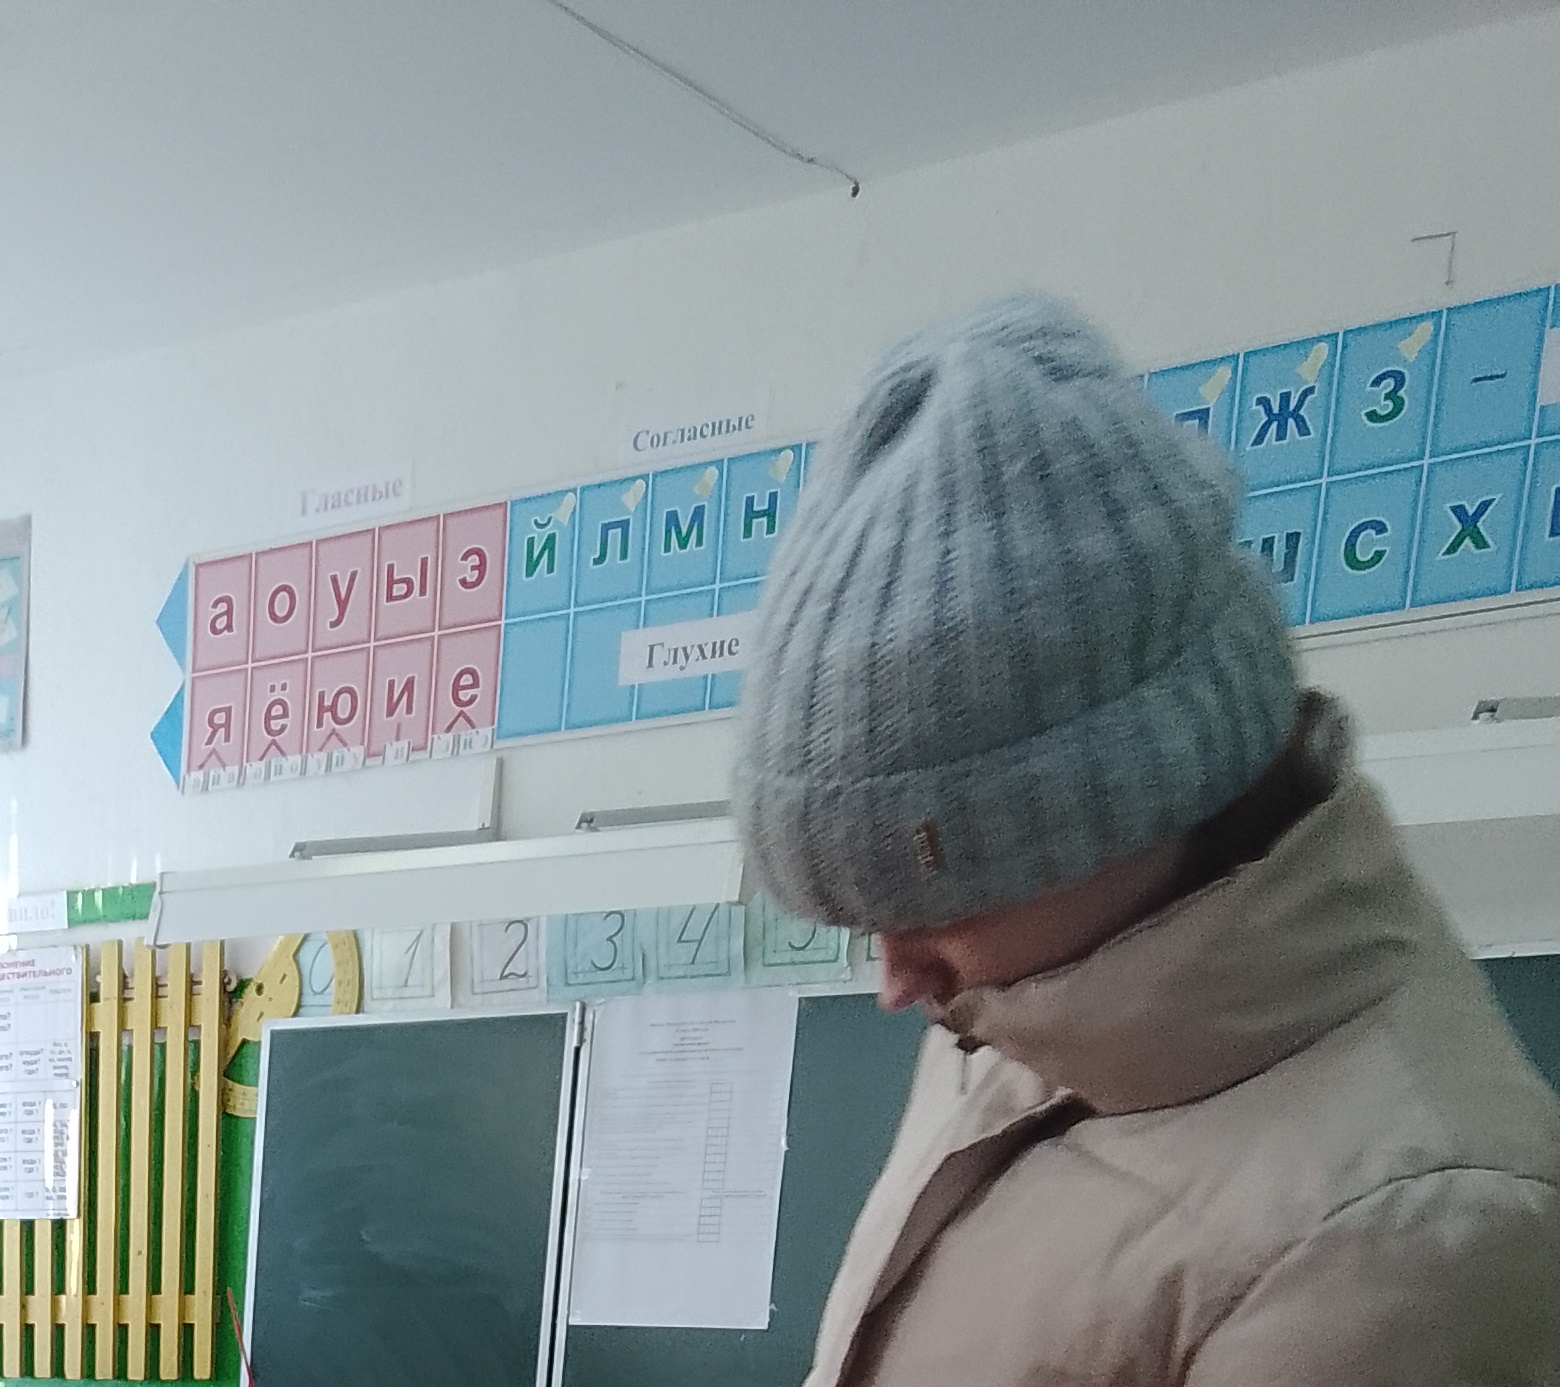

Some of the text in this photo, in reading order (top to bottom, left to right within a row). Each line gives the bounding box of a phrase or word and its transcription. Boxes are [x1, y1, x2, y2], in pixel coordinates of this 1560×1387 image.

[632, 413, 756, 453] Согласные
[300, 476, 404, 518] Гласные
[646, 635, 740, 671] Глухие
[404, 929, 424, 987] 1
[499, 919, 529, 981] 2
[590, 910, 626, 972] 3
[677, 902, 721, 966] 4
